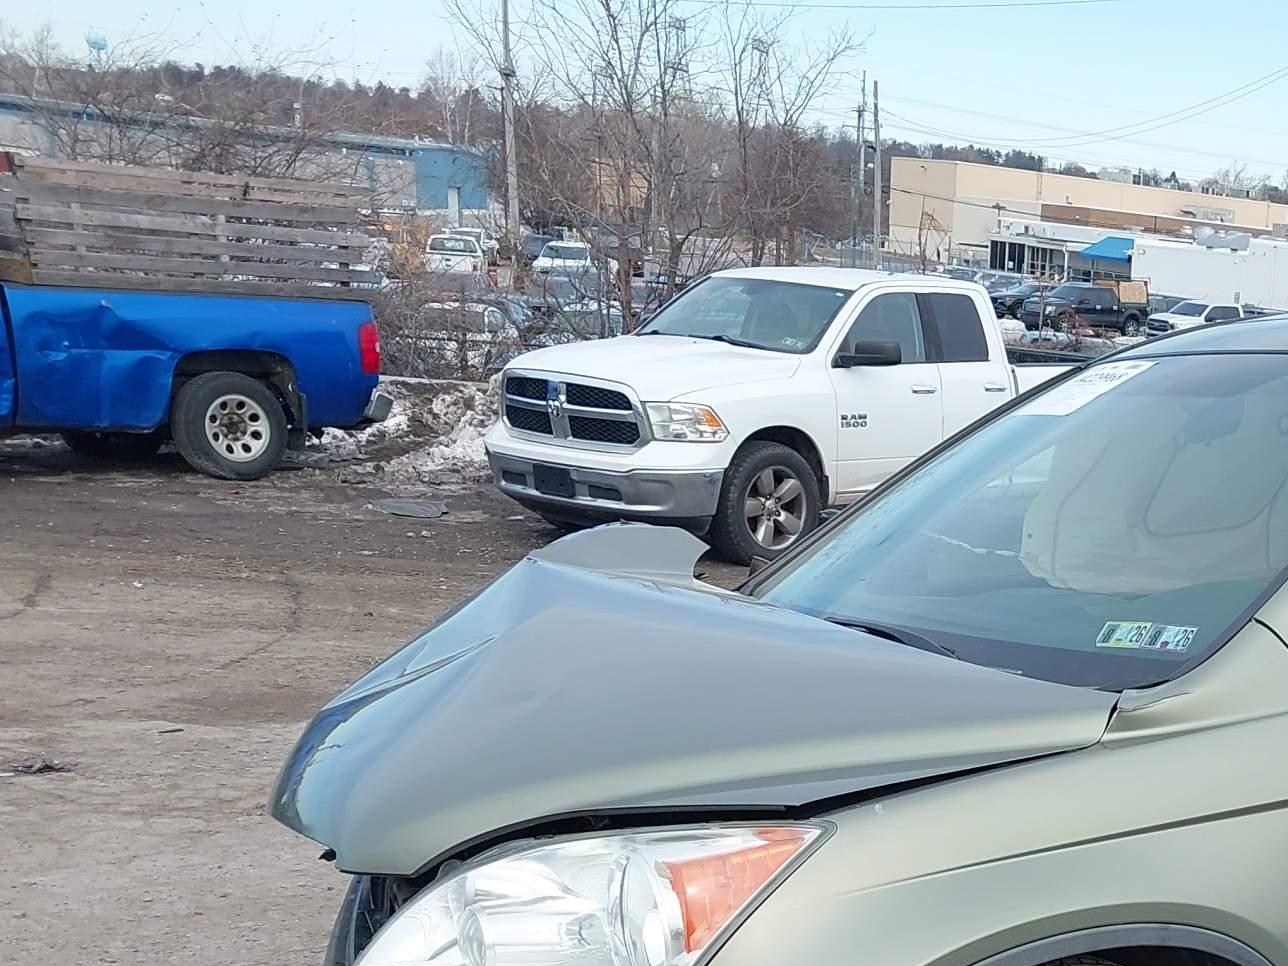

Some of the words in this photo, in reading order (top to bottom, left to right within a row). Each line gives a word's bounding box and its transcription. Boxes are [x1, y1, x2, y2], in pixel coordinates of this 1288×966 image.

[840, 420, 868, 429] 1500
[1128, 625, 1147, 643] 26
[1175, 629, 1195, 648] 26
